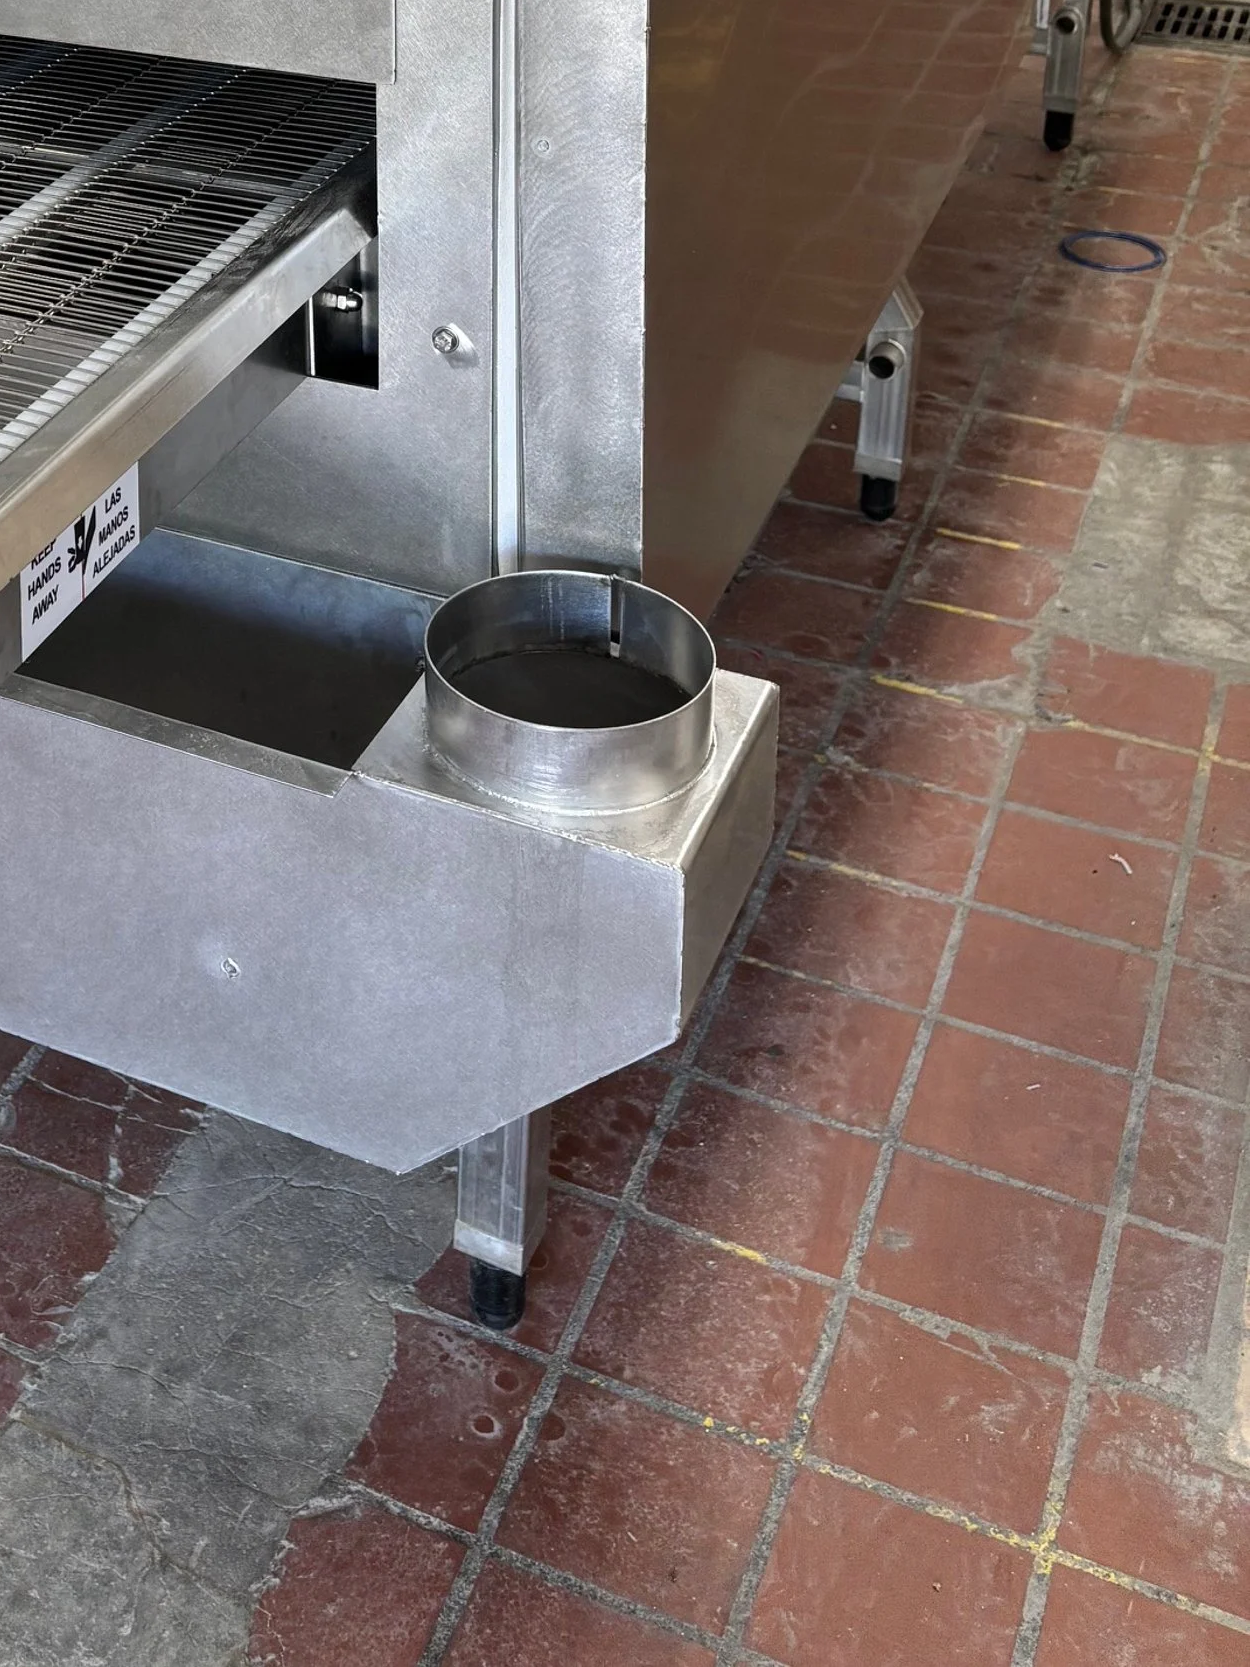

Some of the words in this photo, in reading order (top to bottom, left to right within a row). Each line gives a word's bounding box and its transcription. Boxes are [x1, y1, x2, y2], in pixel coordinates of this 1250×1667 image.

[104, 487, 122, 514] LAS
[99, 506, 129, 547] MANOS
[92, 525, 136, 579] ALEJADAS
[28, 556, 62, 601] HANDS
[32, 584, 59, 625] AWAY
